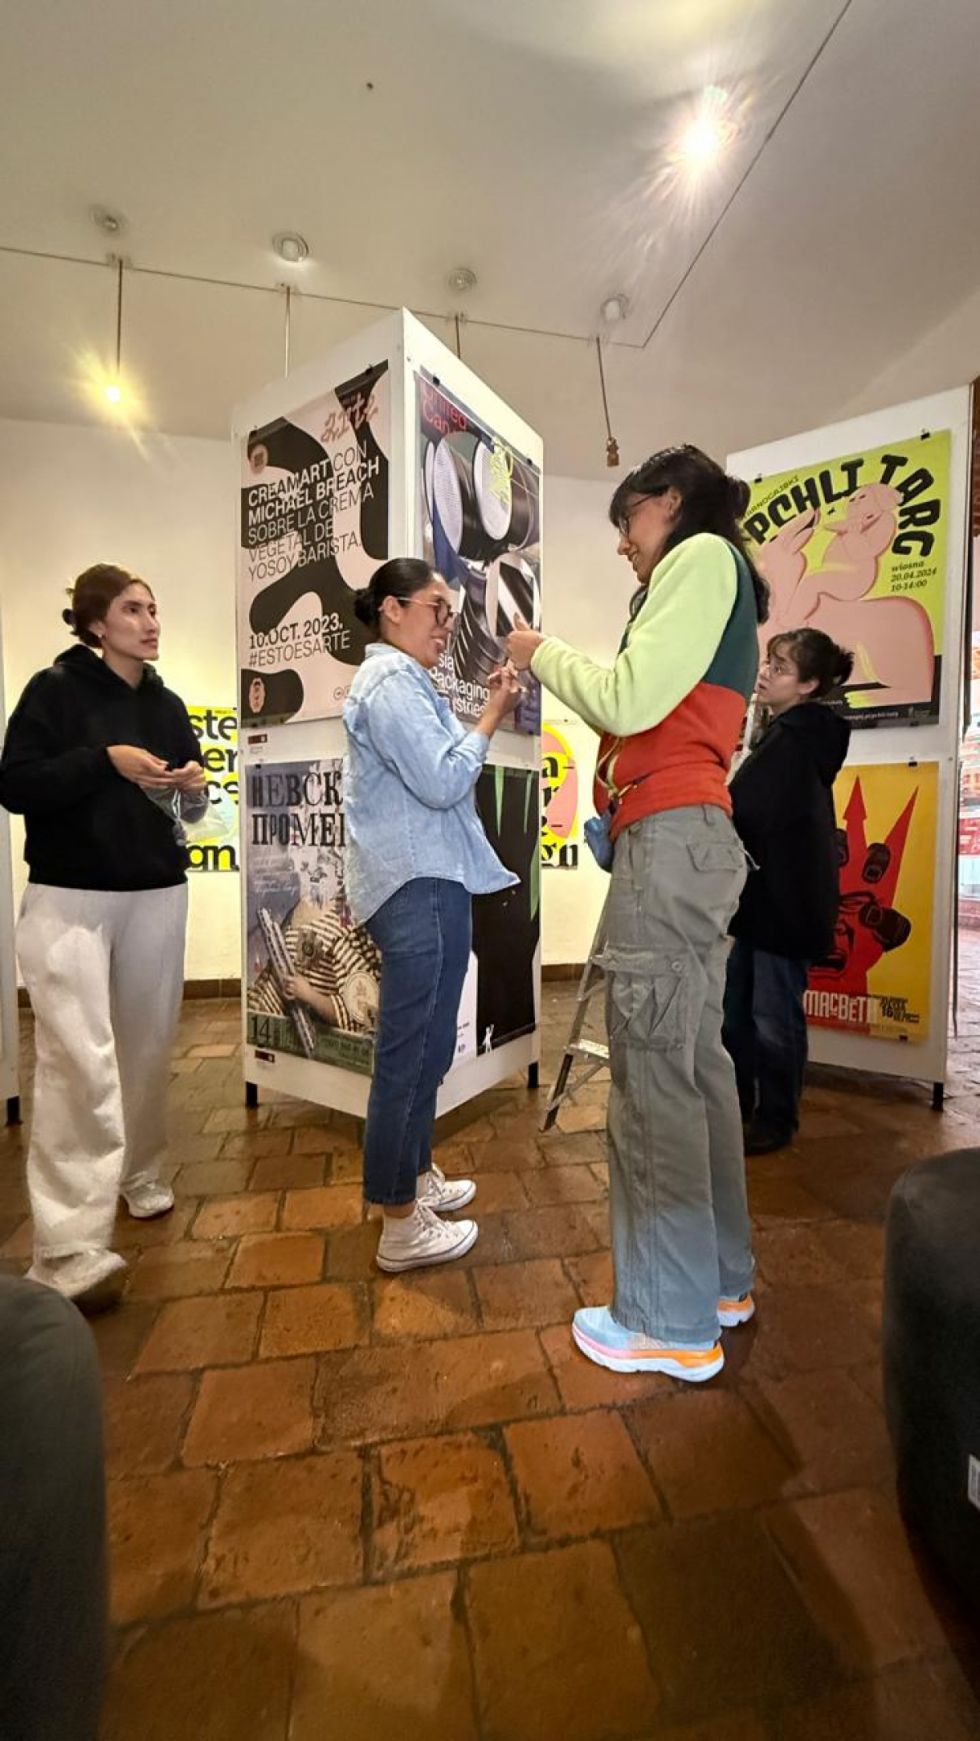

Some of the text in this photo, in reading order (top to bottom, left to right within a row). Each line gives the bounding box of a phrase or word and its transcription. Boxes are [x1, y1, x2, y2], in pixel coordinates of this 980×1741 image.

[248, 439, 368, 507] CREAMART CON
[248, 455, 380, 527] MICHAEL BREACH
[248, 481, 375, 545] SOBRE LA CREMA
[743, 453, 941, 557] PCHLI TARG
[248, 518, 334, 563] VEGETAL DE
[249, 629, 351, 668] #ESTOESARTE
[304, 611, 344, 637] 2023.
[439, 650, 455, 672] sia
